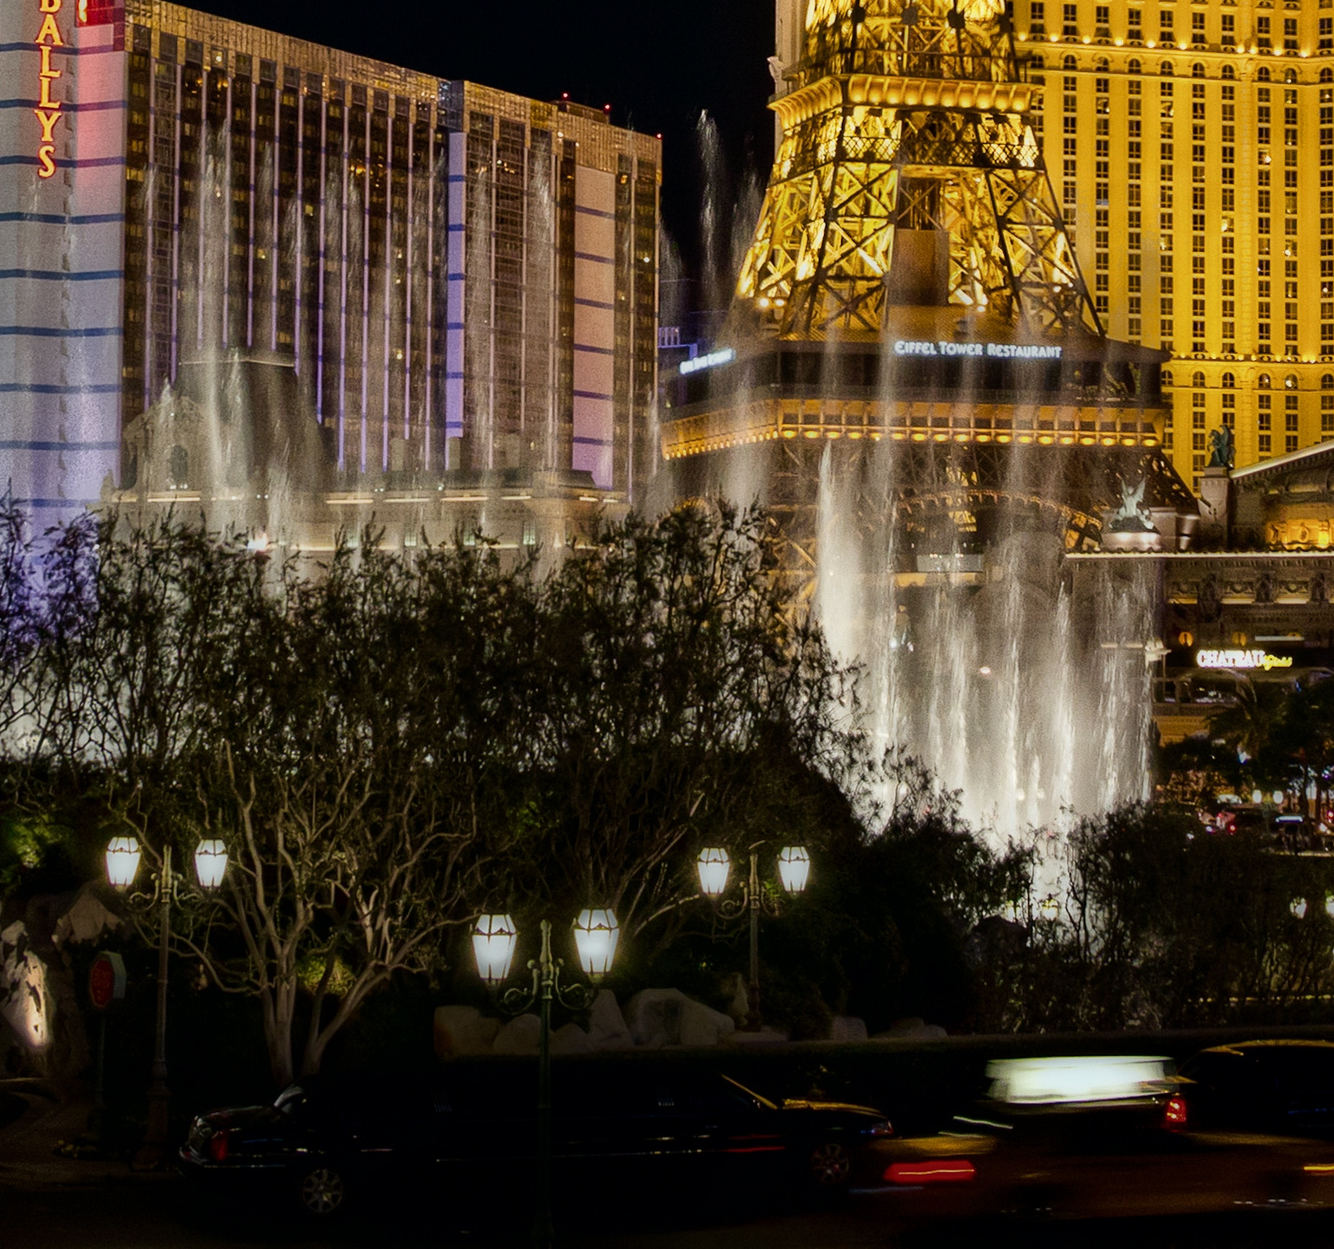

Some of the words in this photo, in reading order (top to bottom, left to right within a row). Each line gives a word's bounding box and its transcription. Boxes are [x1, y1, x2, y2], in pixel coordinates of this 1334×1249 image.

[894, 340, 937, 355] EIFFEL
[938, 341, 983, 356] TOWER
[987, 343, 1062, 358] RESTAURANT
